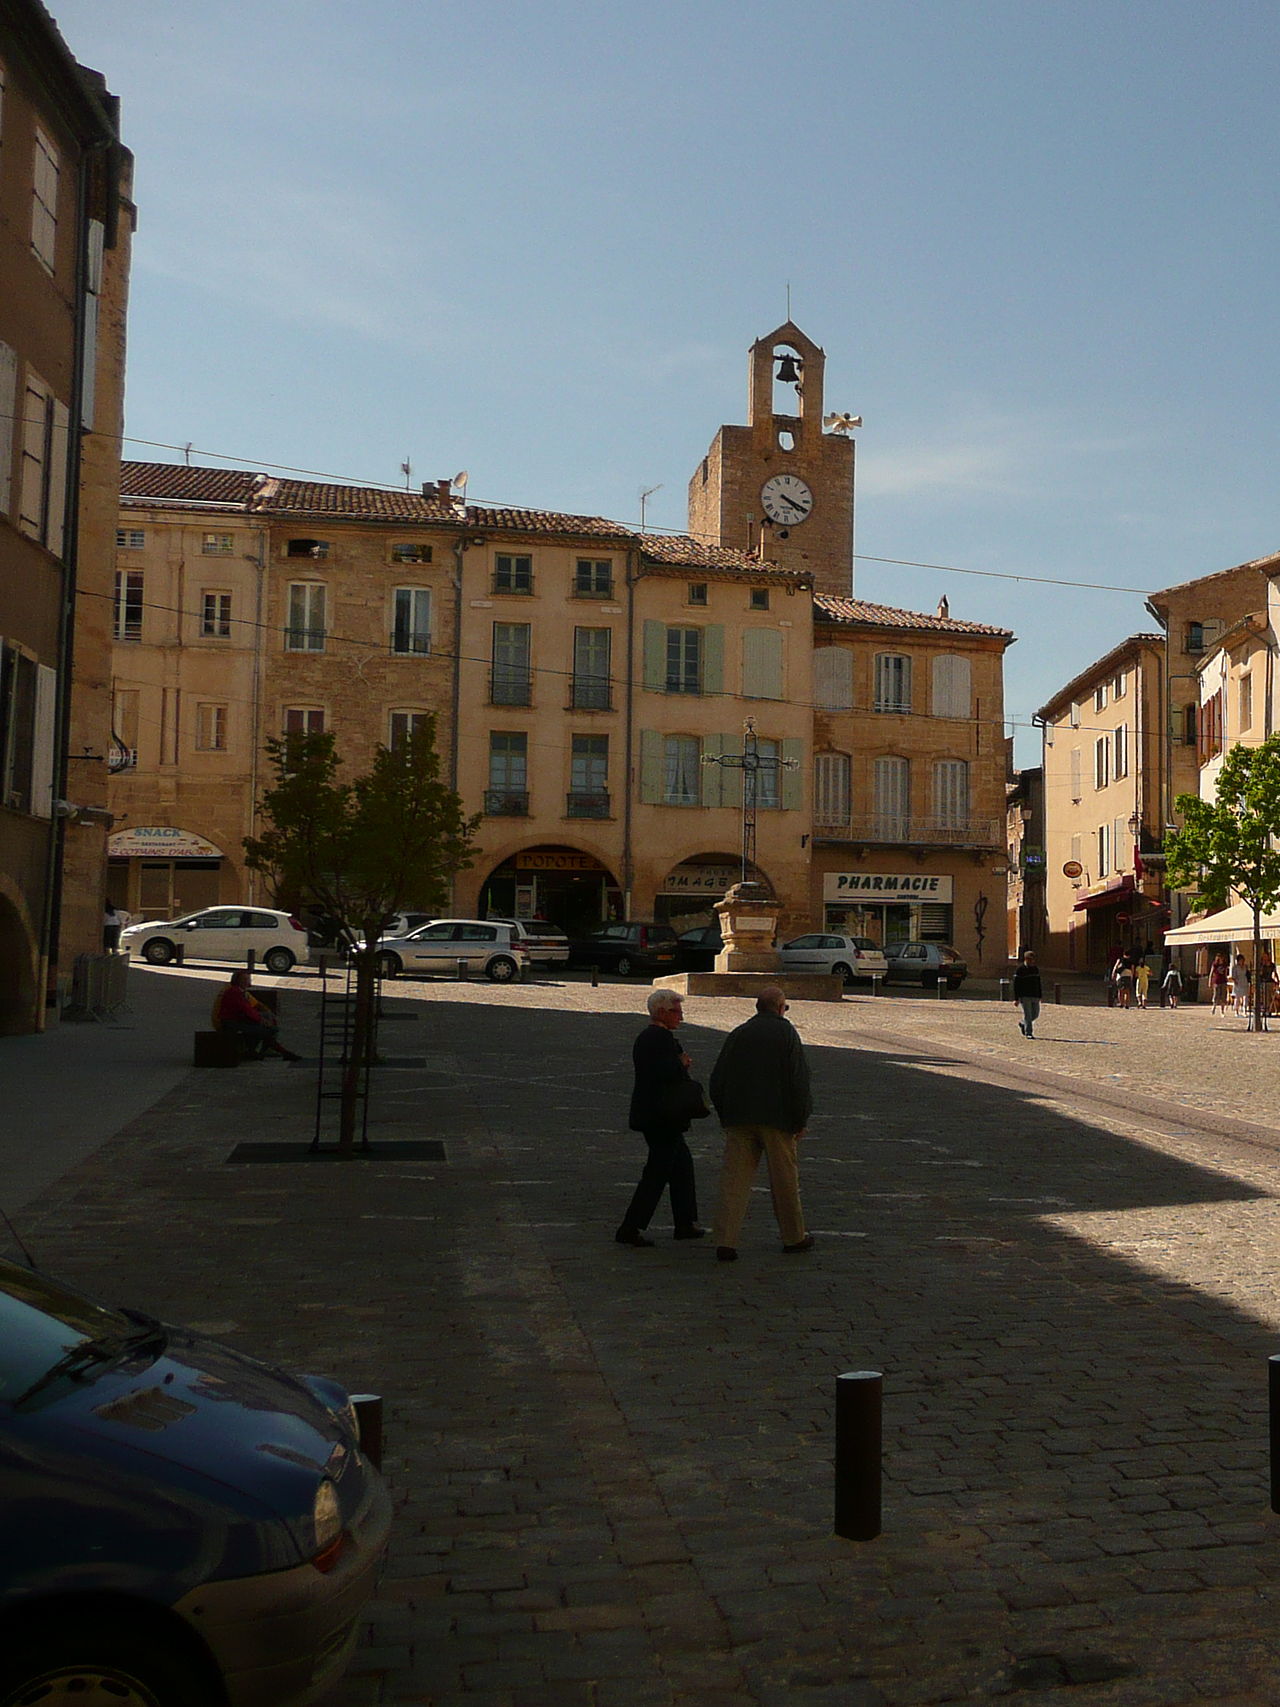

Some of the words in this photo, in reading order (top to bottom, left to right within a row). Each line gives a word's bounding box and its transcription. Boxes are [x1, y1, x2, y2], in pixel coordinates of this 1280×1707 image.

[134, 828, 182, 837] SNACK
[522, 855, 587, 869] POPOTE
[837, 876, 939, 890] PHARMACIE
